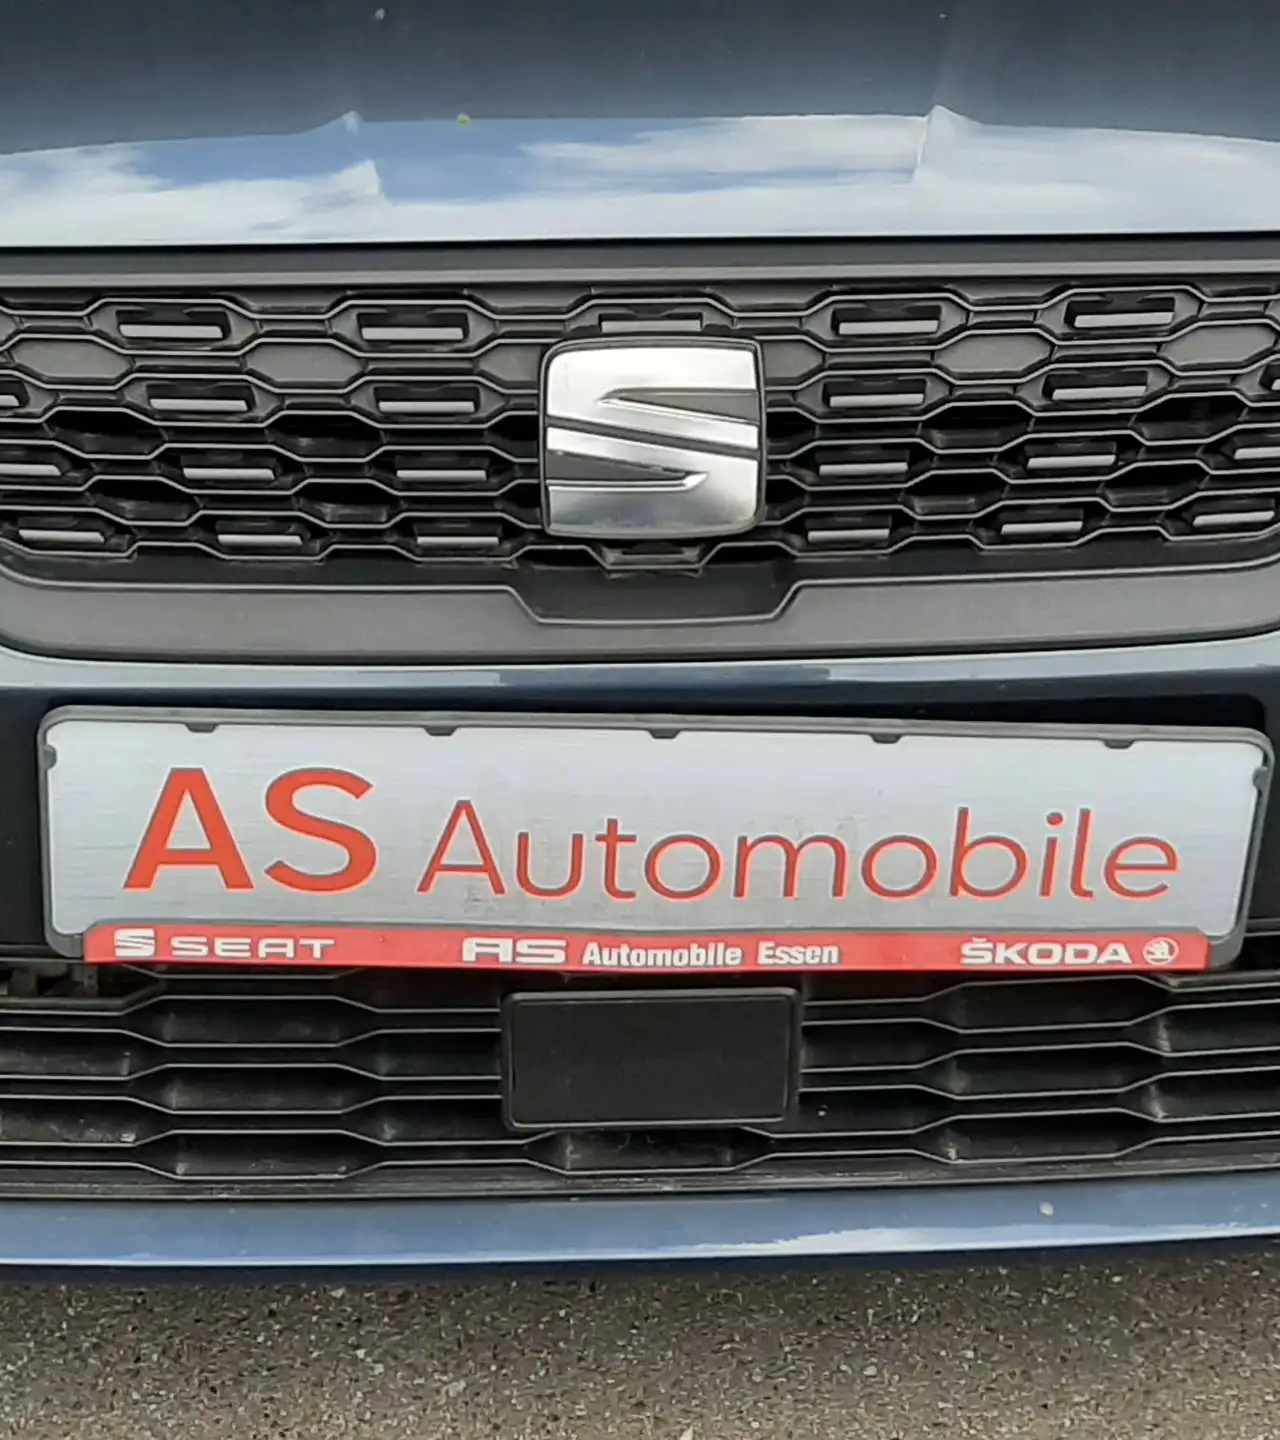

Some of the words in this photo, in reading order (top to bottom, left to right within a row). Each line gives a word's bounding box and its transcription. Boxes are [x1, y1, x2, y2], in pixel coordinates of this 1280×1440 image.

[120, 765, 380, 894] AS
[413, 797, 1181, 902] Automobile
[170, 935, 336, 960] SEAT
[461, 936, 569, 964] AS
[581, 940, 743, 968] Automobile
[757, 940, 841, 966] Essen
[959, 936, 1134, 966] ŠKODA
